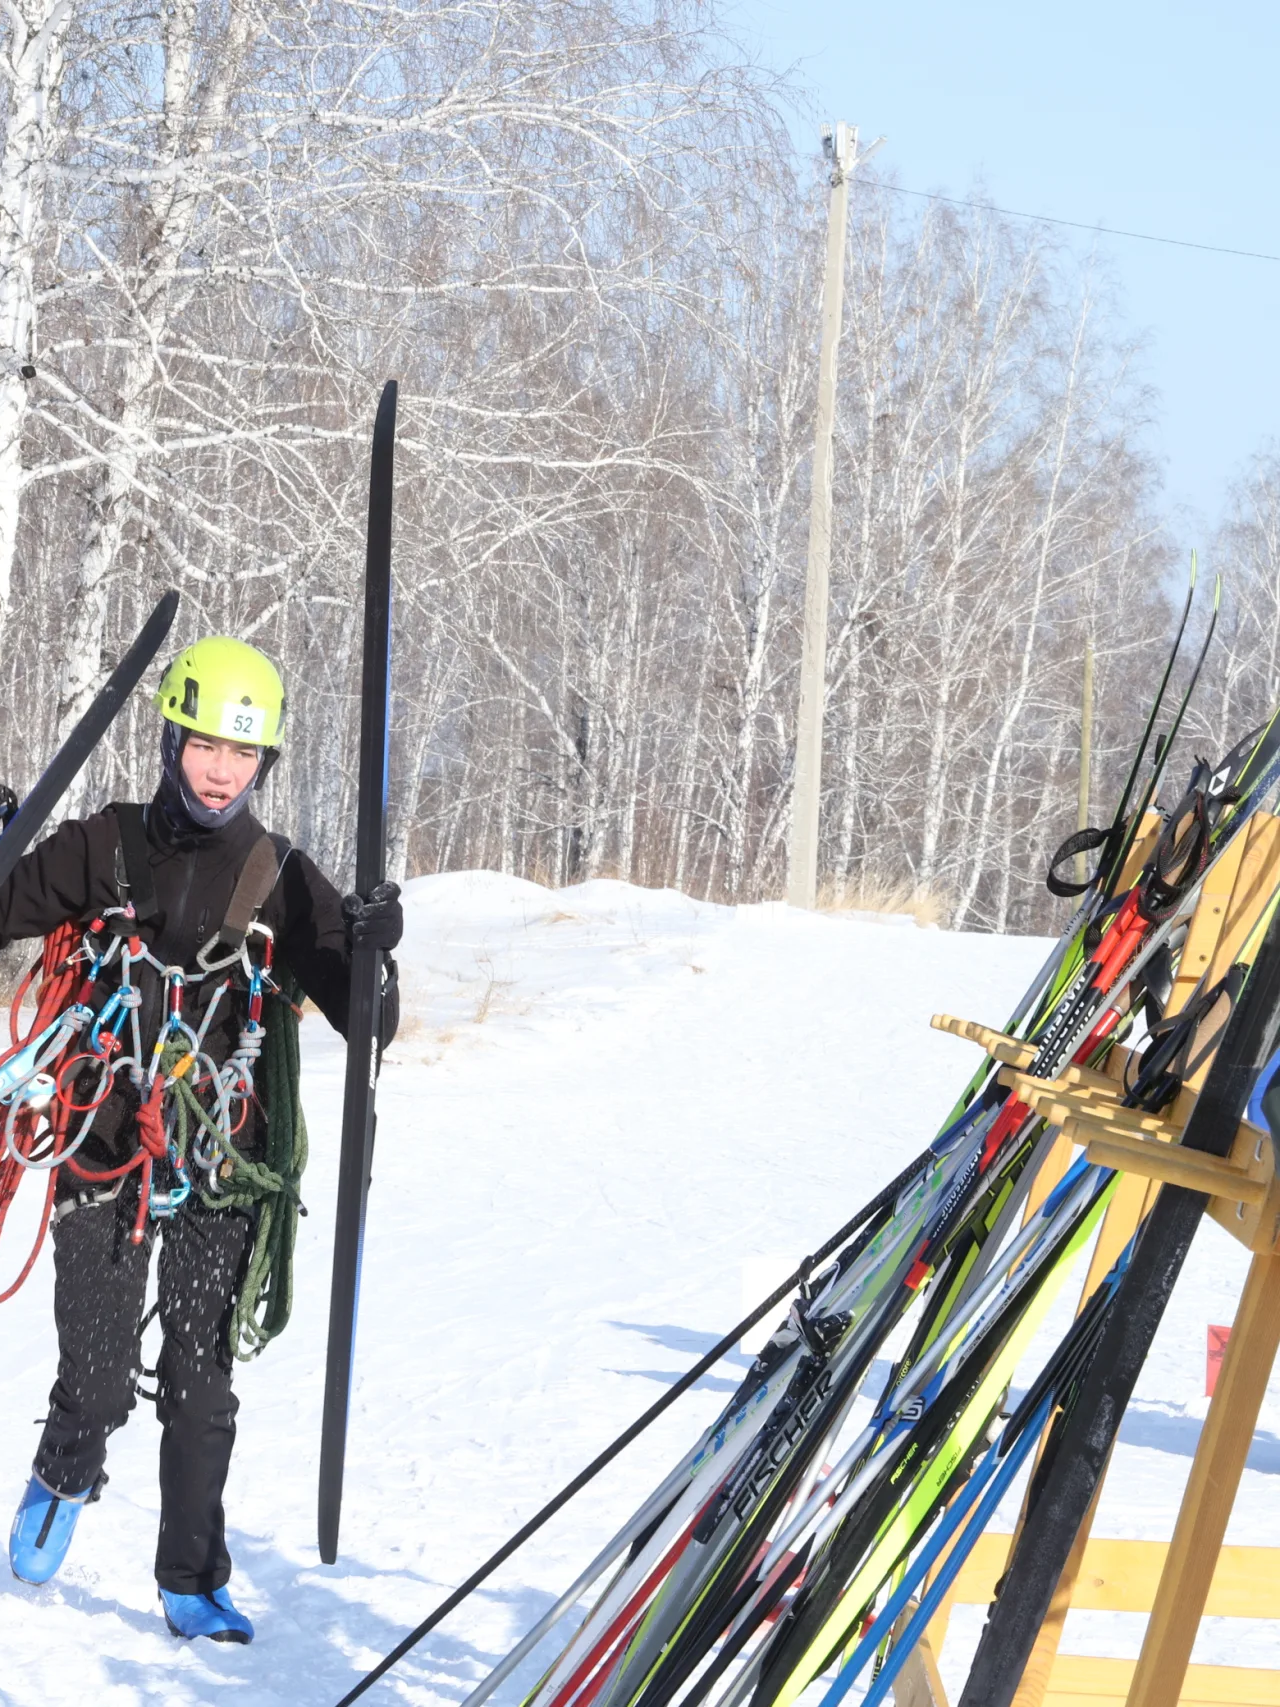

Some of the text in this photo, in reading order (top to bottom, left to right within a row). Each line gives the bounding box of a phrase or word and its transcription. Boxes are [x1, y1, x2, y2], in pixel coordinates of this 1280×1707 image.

[233, 715, 254, 733] 52
[733, 1370, 835, 1522] FISCHER
[890, 1442, 919, 1485] FISCHER
[936, 1447, 962, 1487] FISCHER
